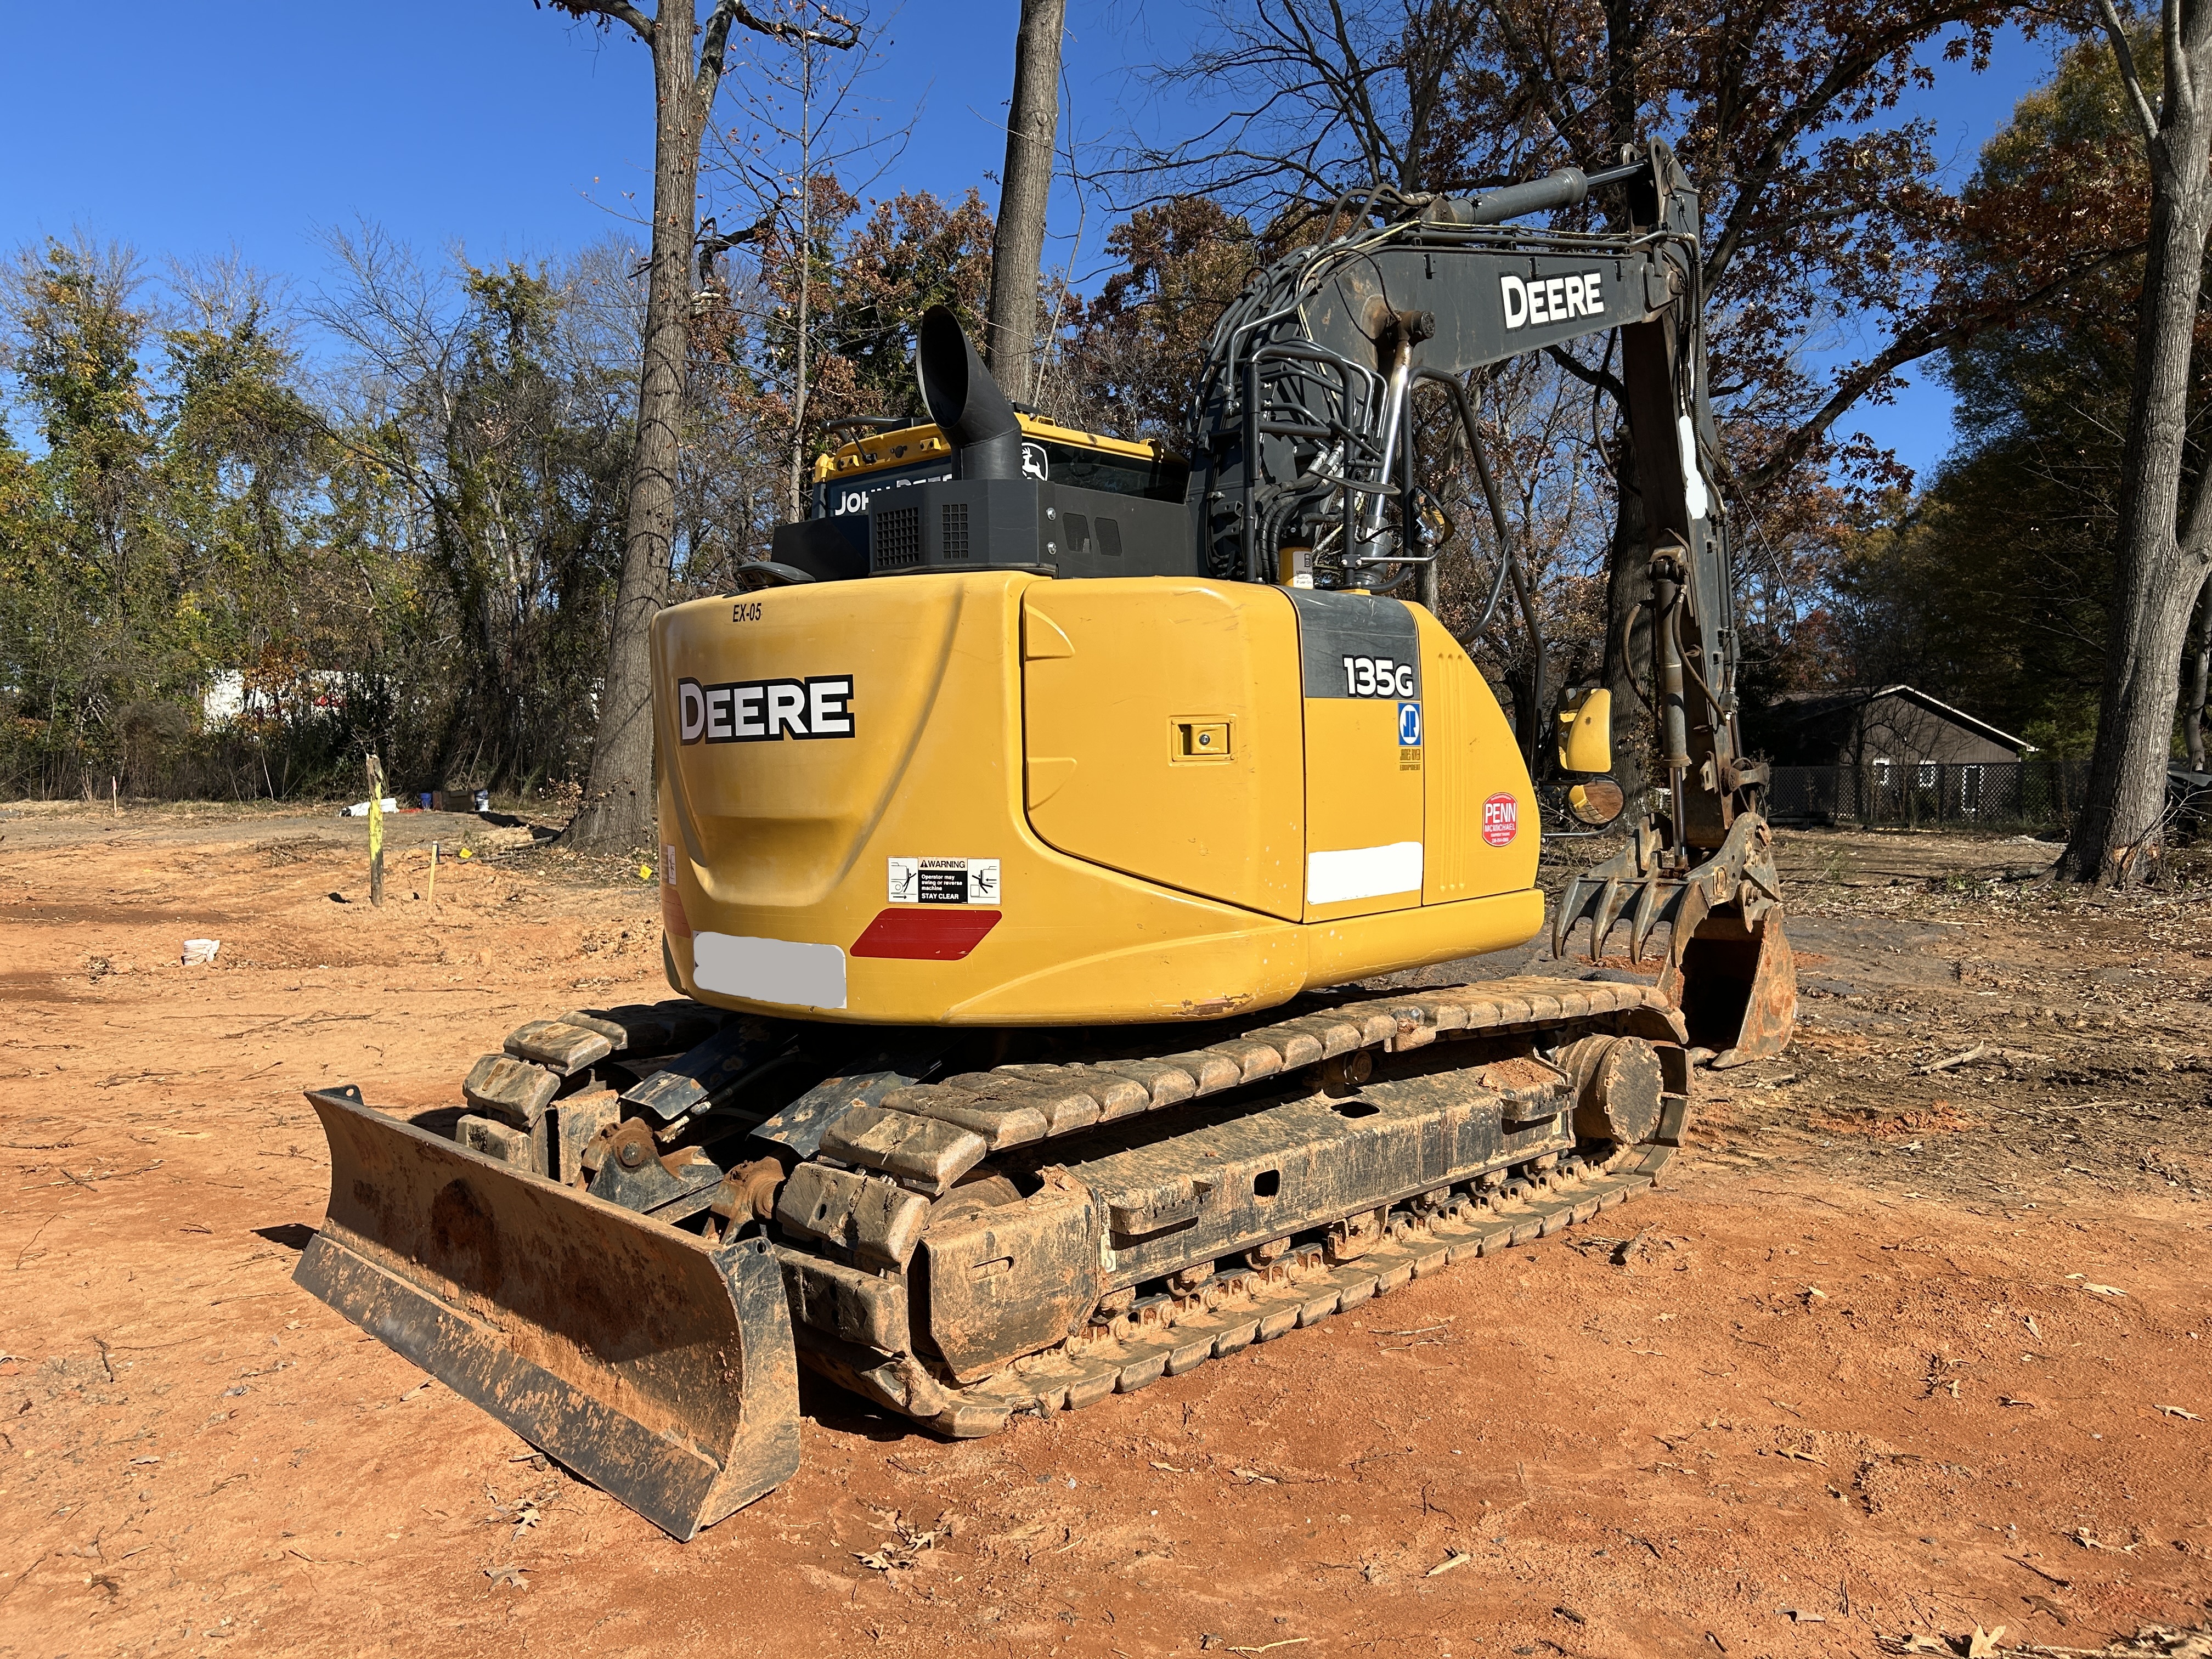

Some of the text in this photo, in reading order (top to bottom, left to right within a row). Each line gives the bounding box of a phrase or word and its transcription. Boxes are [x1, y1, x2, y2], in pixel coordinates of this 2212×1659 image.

[1500, 273, 1605, 329] DEERE
[834, 486, 890, 516] JOH
[733, 602, 761, 622] EX-05
[1342, 656, 1414, 698] 135G
[679, 679, 852, 743] DEERE
[1485, 802, 1516, 824] PENN
[927, 860, 966, 868] WARNING
